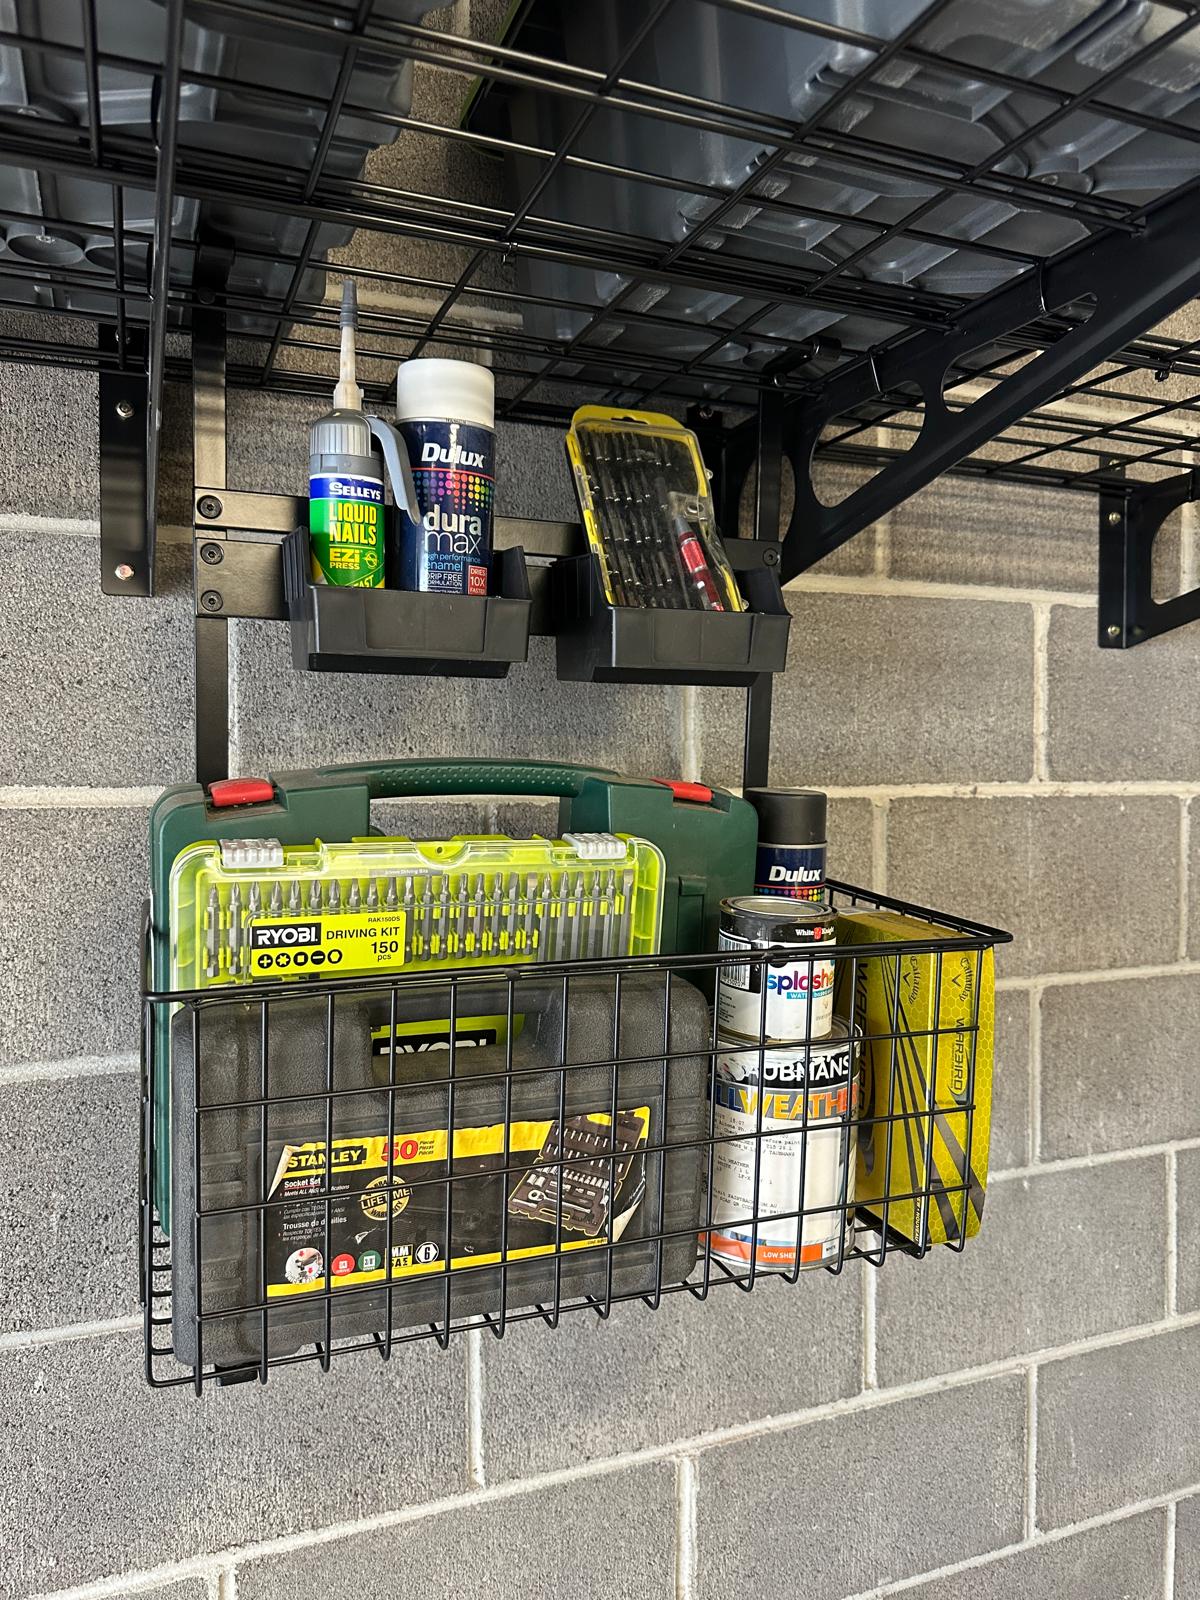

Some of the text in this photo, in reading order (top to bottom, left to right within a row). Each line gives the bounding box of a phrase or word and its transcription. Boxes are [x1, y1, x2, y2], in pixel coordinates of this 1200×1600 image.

[421, 442, 484, 468] Dulux
[329, 482, 381, 500] SELLEYS
[329, 502, 377, 525] LIQUID
[423, 503, 482, 536] dura
[329, 522, 377, 545] NAILS
[423, 531, 482, 555] max
[329, 561, 360, 570] PRESS
[440, 553, 481, 564] performance
[426, 561, 463, 572] enamel
[470, 568, 486, 576] DRIES
[443, 573, 463, 582] FREE
[470, 576, 485, 588] 10X
[768, 865, 822, 882] Dulux
[256, 926, 401, 946] RYOBI DRIVING KIT
[795, 928, 814, 936] White
[370, 941, 399, 955] 150
[377, 953, 392, 963] pcs
[959, 957, 973, 1002] Callaway
[287, 1148, 362, 1169] STANLEY
[381, 1140, 419, 1162] 50
[284, 1177, 321, 1188] Socket Set
[361, 1187, 410, 1210] LIFETME
[282, 1221, 309, 1231] Trousse
[310, 1219, 319, 1228] de
[424, 1246, 431, 1261] 6
[763, 1251, 780, 1259] LOW
